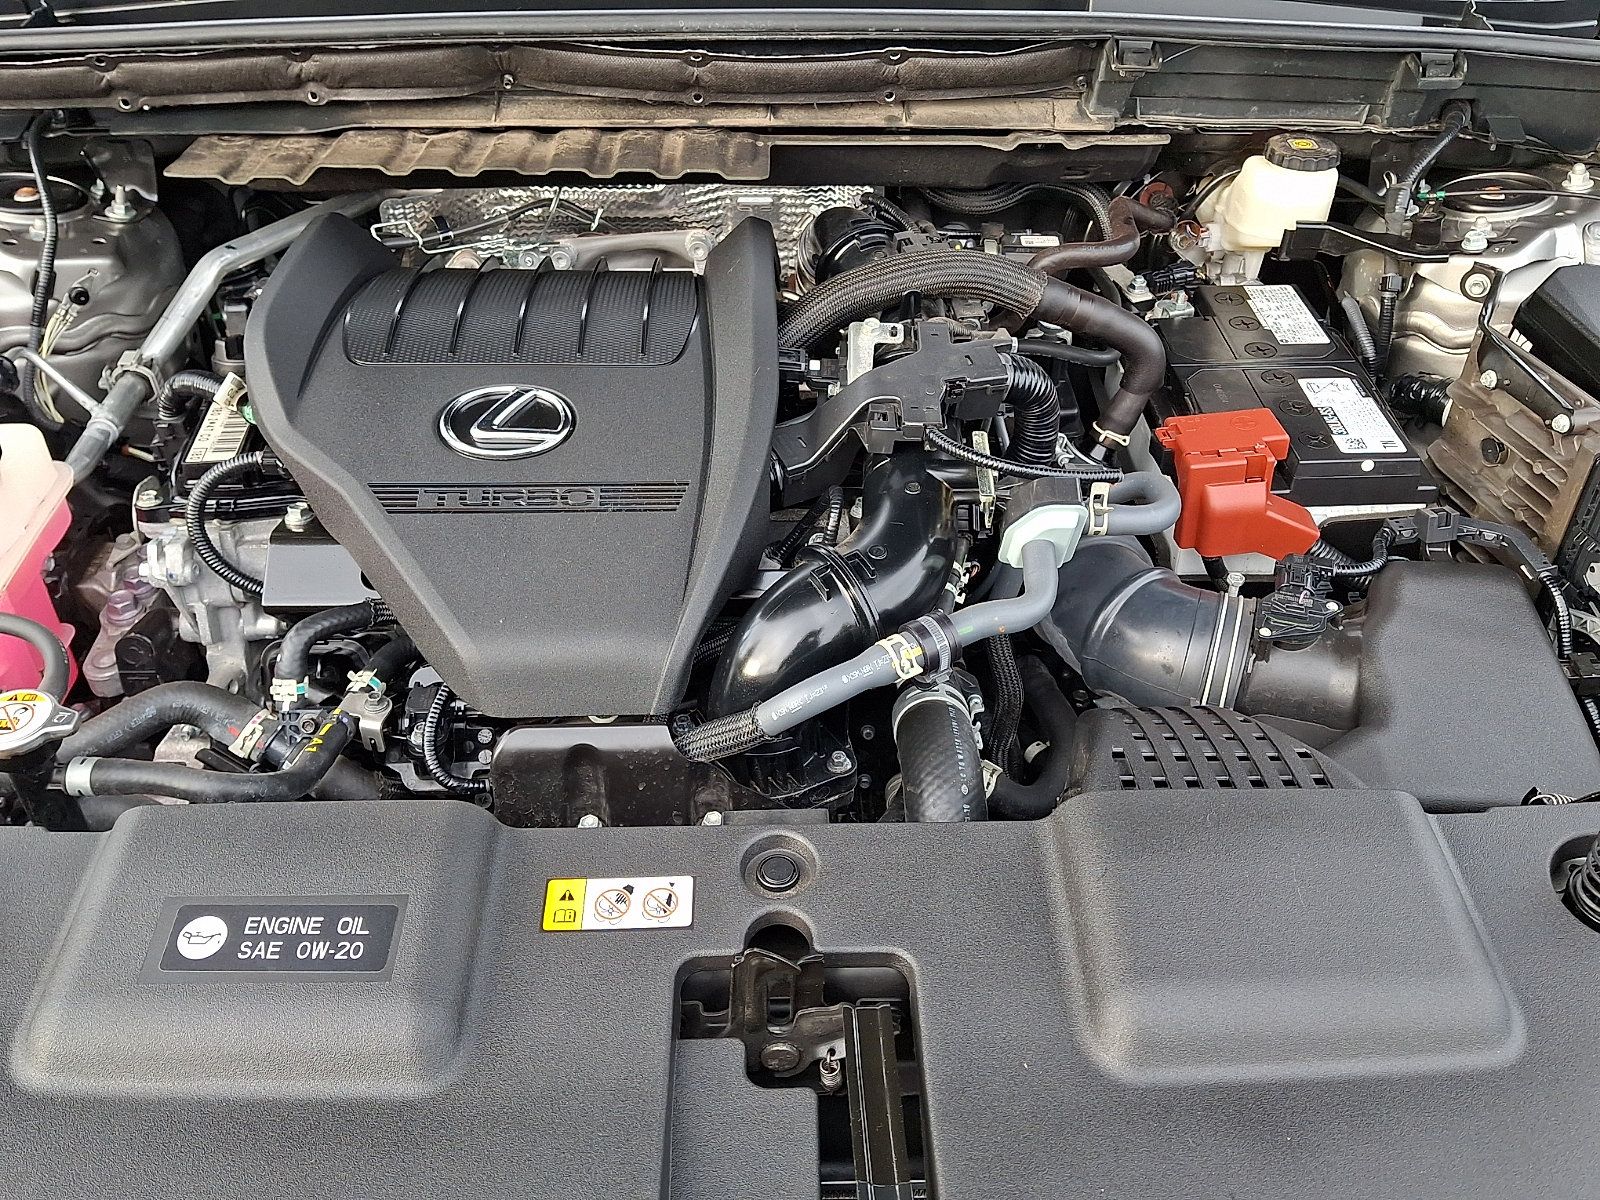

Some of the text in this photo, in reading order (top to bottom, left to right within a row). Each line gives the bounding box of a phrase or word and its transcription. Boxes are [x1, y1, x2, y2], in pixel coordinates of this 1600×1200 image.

[420, 488, 599, 507] TURBO
[244, 916, 369, 935] ENGINE OIL
[237, 941, 364, 960] SAE 0W-20
